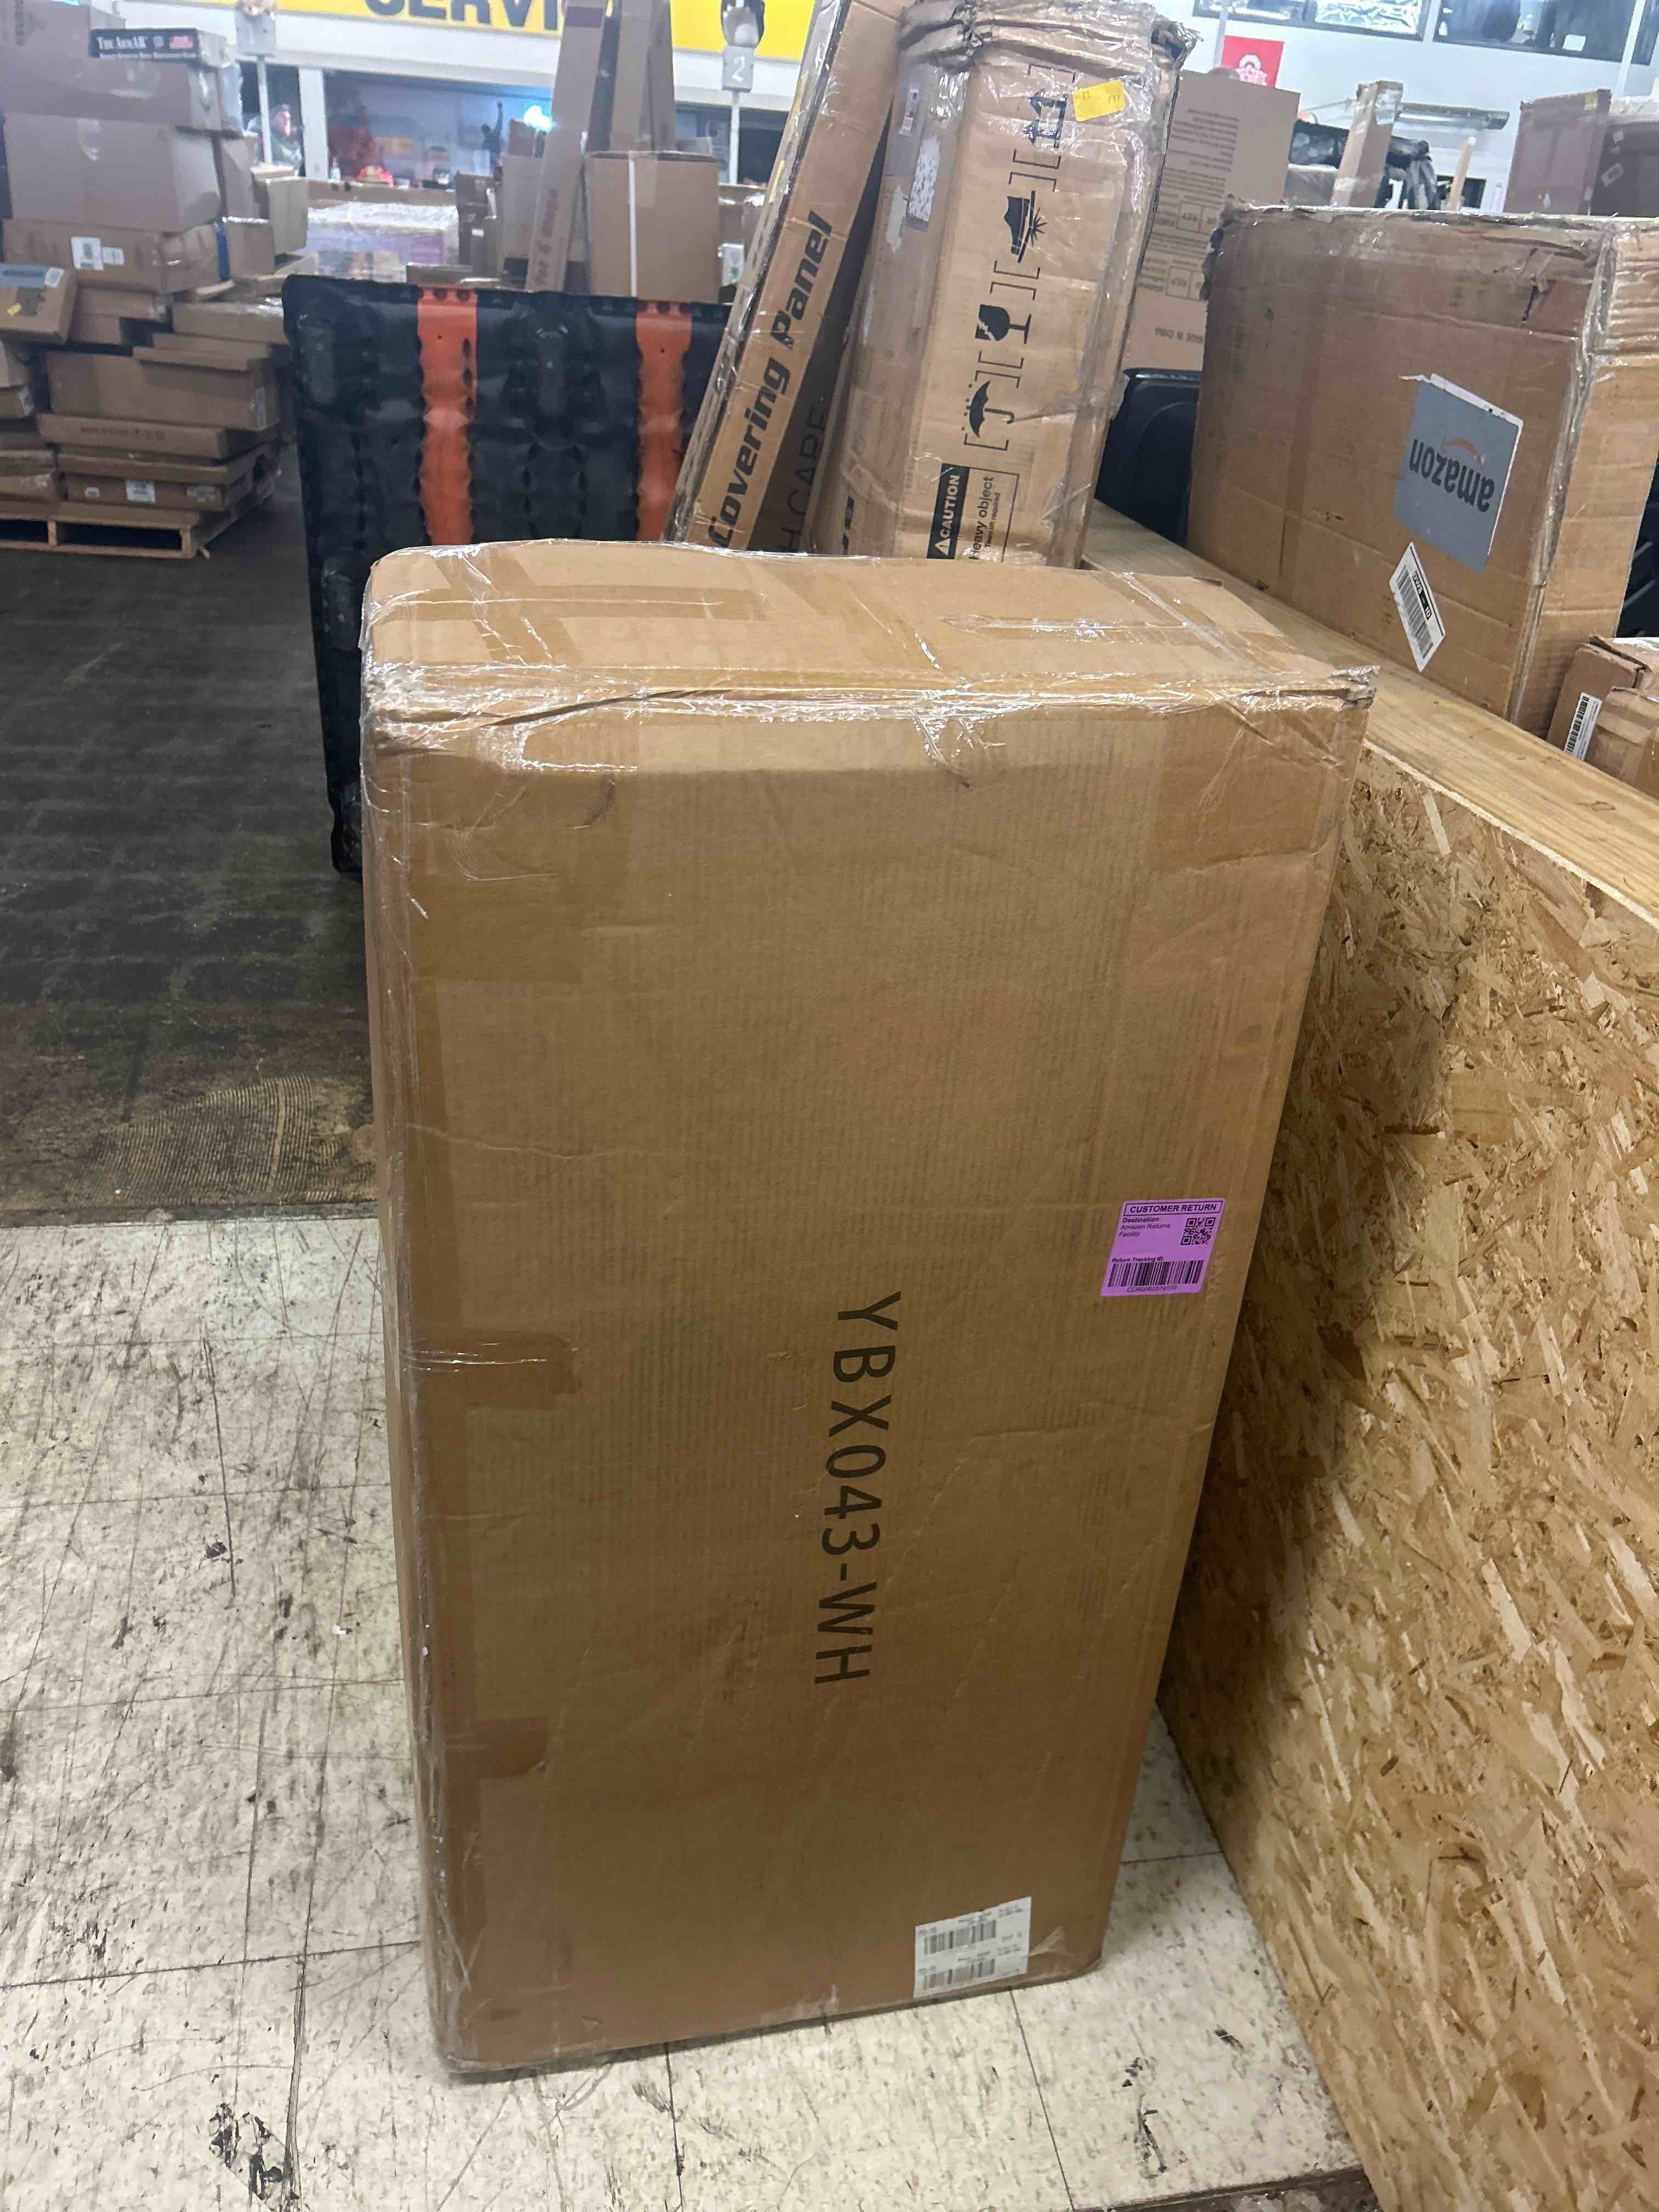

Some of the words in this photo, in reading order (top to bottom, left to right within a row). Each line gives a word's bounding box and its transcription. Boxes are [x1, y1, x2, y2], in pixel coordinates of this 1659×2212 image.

[731, 55, 746, 80] 2
[708, 358, 791, 548] Covering
[771, 210, 833, 350] Panel
[977, 476, 994, 518] object
[1409, 438, 1494, 512] amazon
[940, 475, 960, 538] CAUTION
[984, 532, 994, 548] Team
[991, 493, 1001, 521] required
[969, 521, 988, 560] Heavy
[1130, 1205, 1179, 1213] CUSTOMER
[814, 1290, 901, 1684] YBX043-WH
